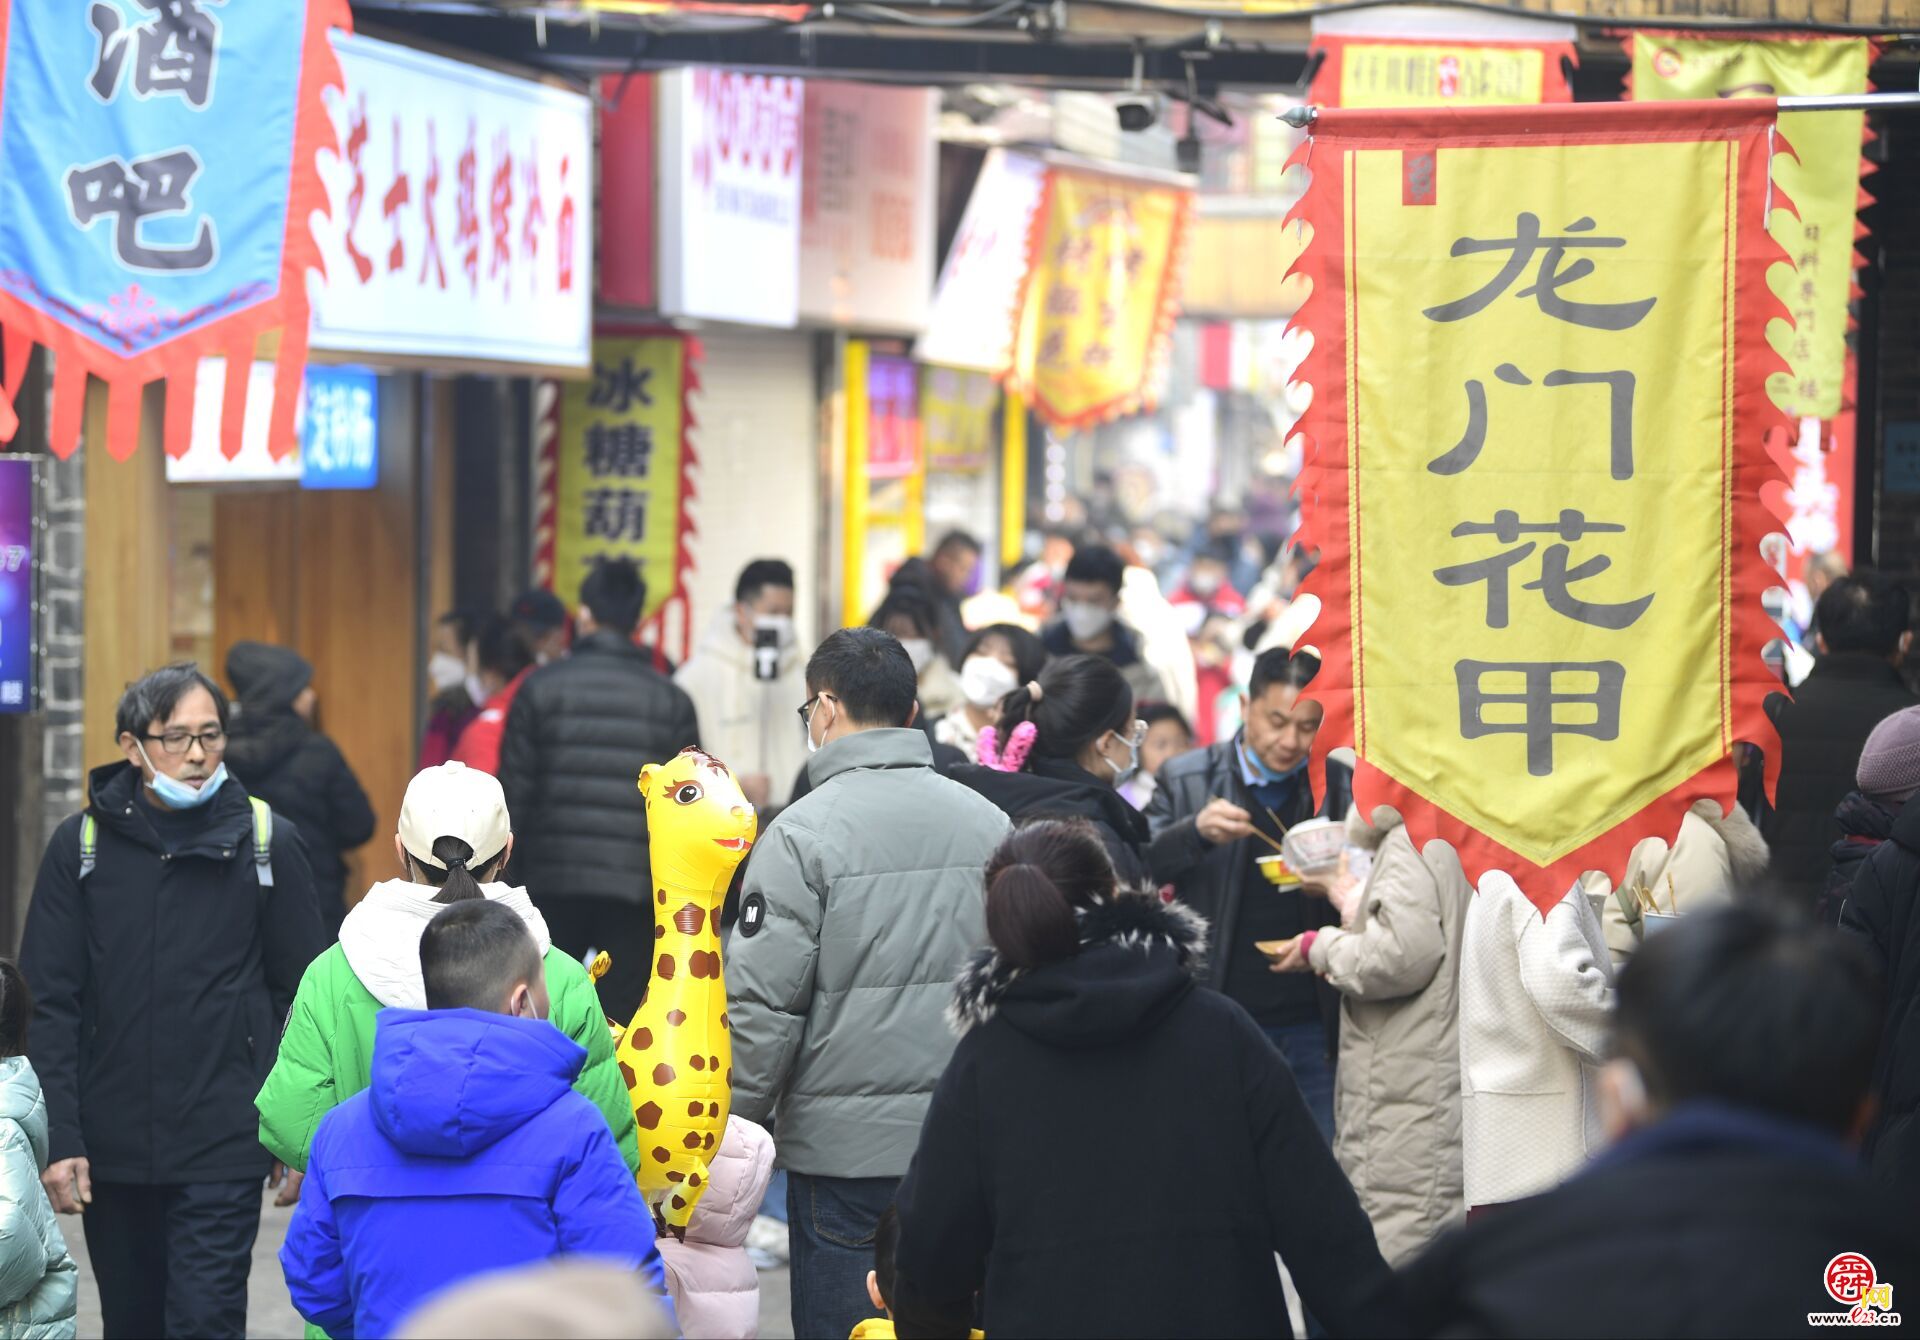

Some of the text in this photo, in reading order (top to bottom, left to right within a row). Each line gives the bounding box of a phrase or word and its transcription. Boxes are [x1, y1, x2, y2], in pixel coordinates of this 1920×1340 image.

[67, 0, 215, 270] 酒吧
[582, 357, 654, 566] 冰糖葫
[1422, 212, 1657, 777] 龙门花甲
[745, 906, 758, 923] M
